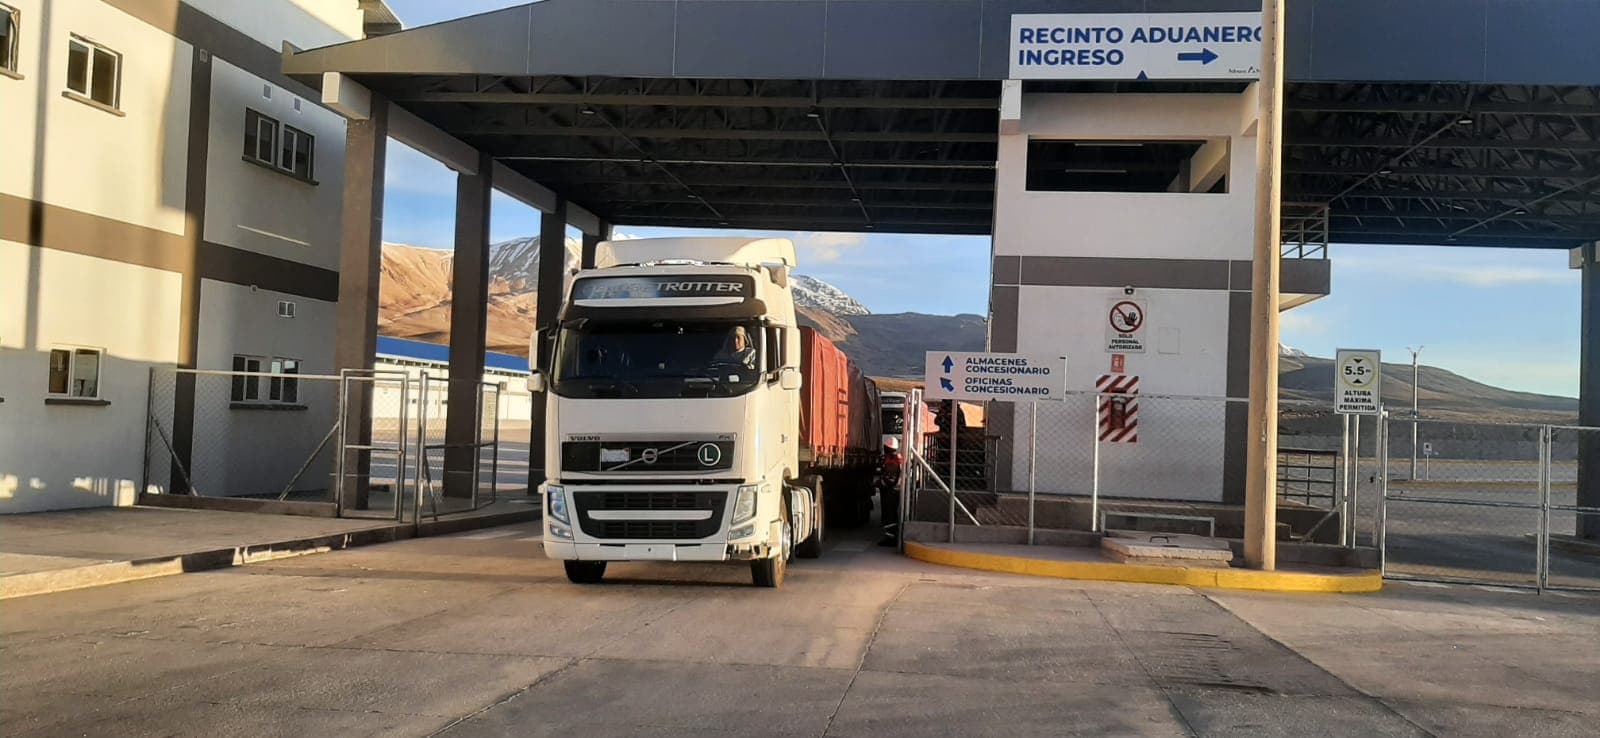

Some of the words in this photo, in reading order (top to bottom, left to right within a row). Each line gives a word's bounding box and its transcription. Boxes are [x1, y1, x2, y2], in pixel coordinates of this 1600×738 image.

[1019, 26, 1124, 44] RECINTO
[1018, 49, 1124, 66] INGRESO
[966, 357, 1028, 366] ALMACENES
[965, 365, 1050, 375] CONCESIONARIO
[1345, 365, 1365, 375] 5.5
[965, 377, 1013, 386] OFICINAS
[964, 385, 1050, 395] CONCESIONARIO
[704, 447, 714, 462] L
